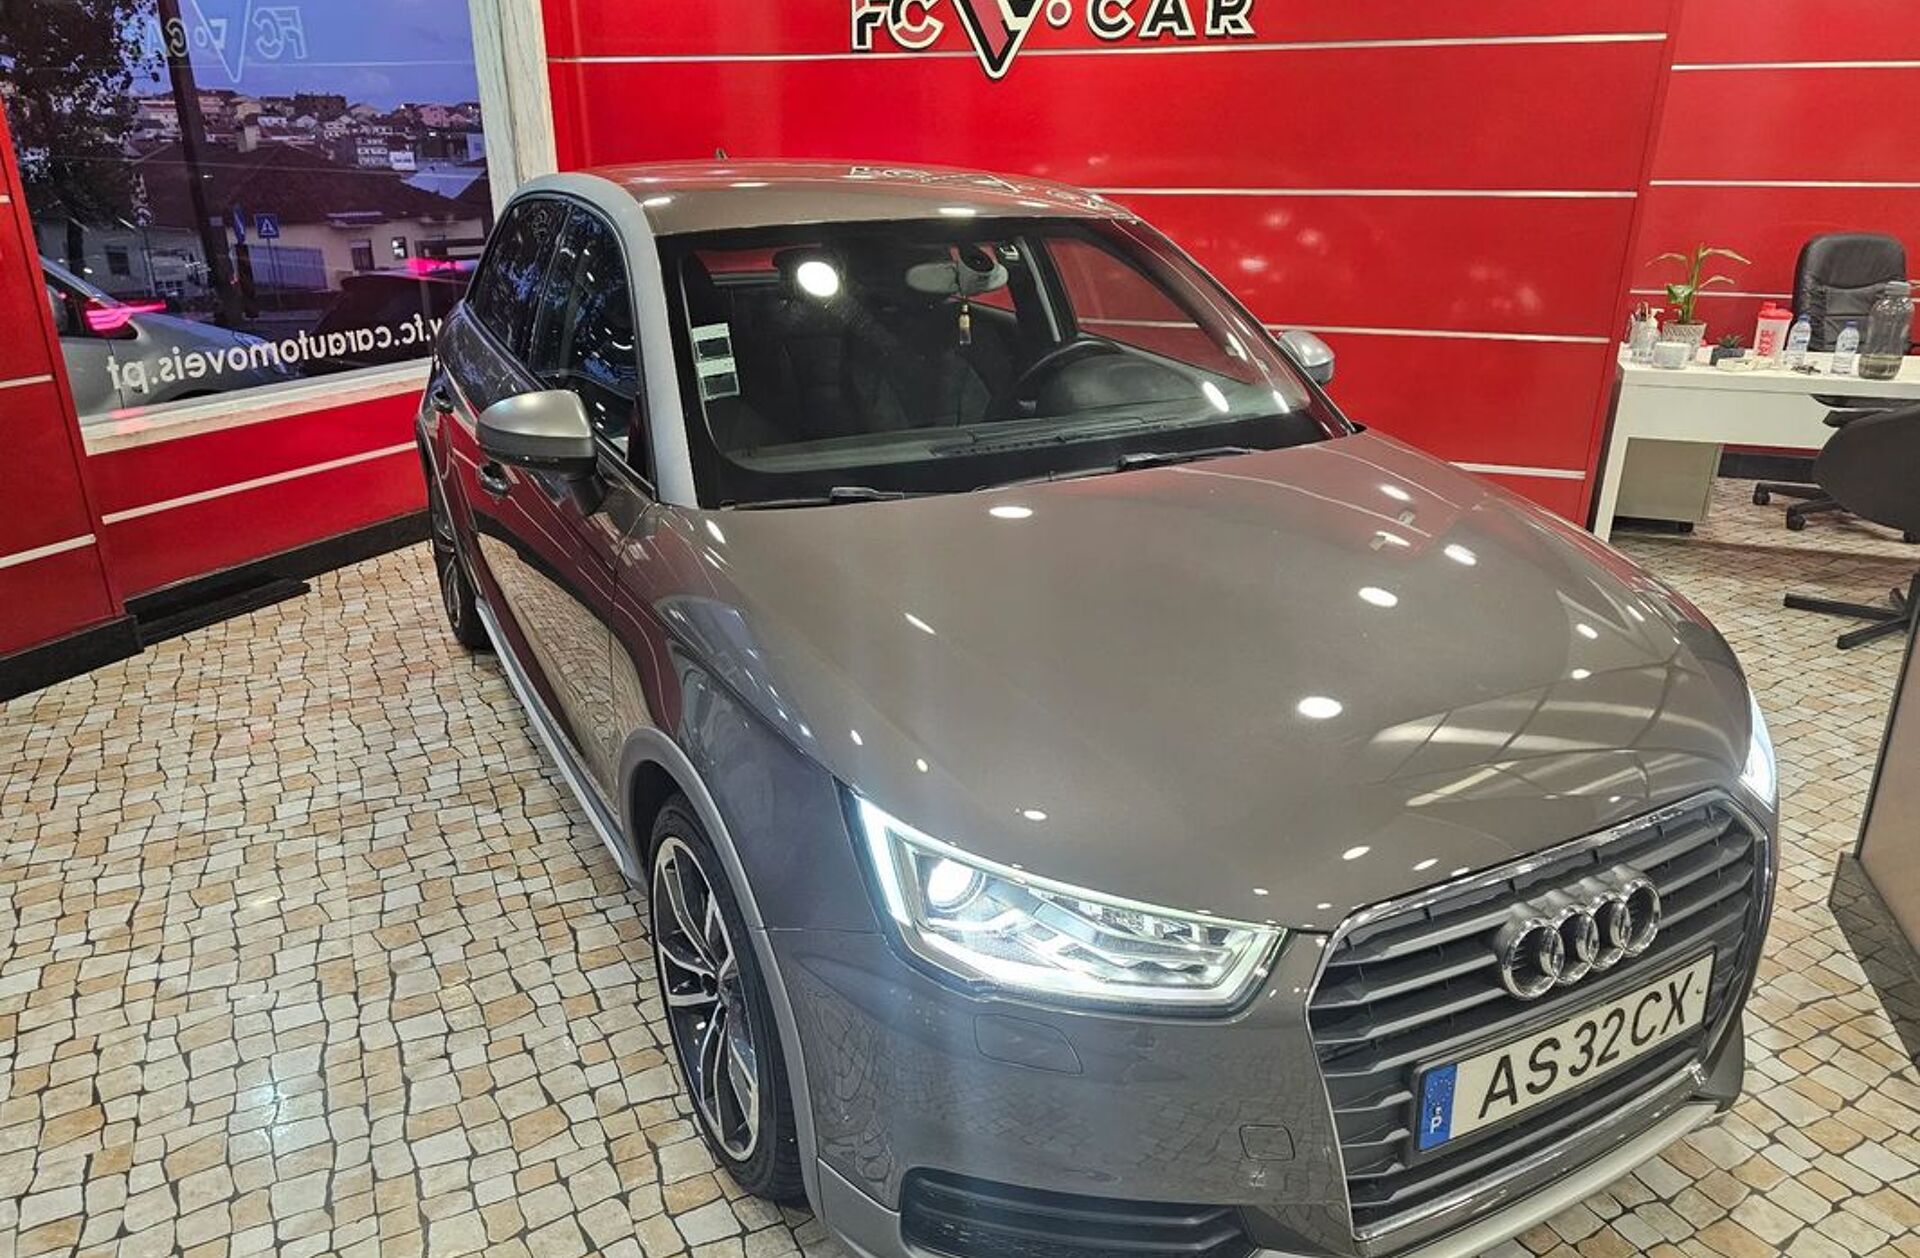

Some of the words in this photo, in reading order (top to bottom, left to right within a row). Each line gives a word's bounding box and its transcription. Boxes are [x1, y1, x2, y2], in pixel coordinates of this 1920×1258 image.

[851, 0, 945, 50] FC
[1086, 0, 1257, 38] CAR
[1429, 1115, 1443, 1135] P
